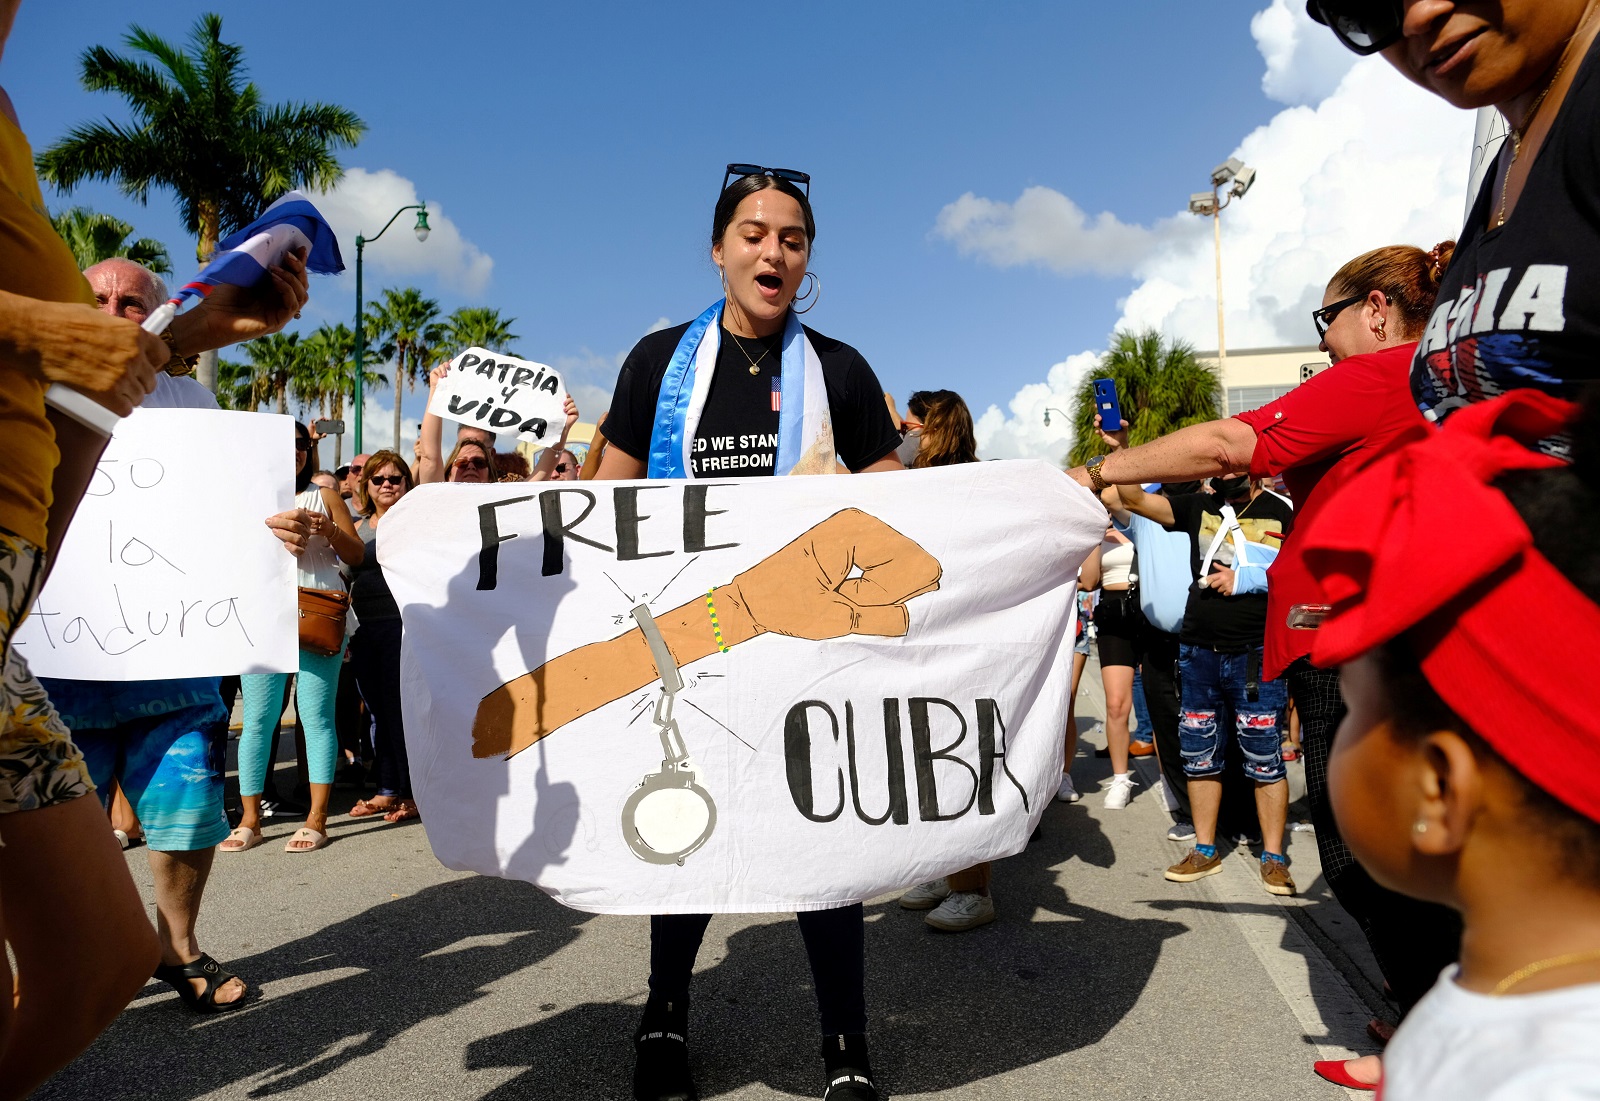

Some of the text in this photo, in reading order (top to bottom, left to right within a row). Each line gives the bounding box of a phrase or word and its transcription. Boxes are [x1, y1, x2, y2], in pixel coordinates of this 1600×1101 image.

[702, 453, 773, 472] FREEDOM
[711, 436, 735, 451] WE
[109, 519, 186, 575] la
[476, 484, 741, 590] FREE
[11, 584, 254, 656] tadura
[783, 697, 1030, 826] CUBA
